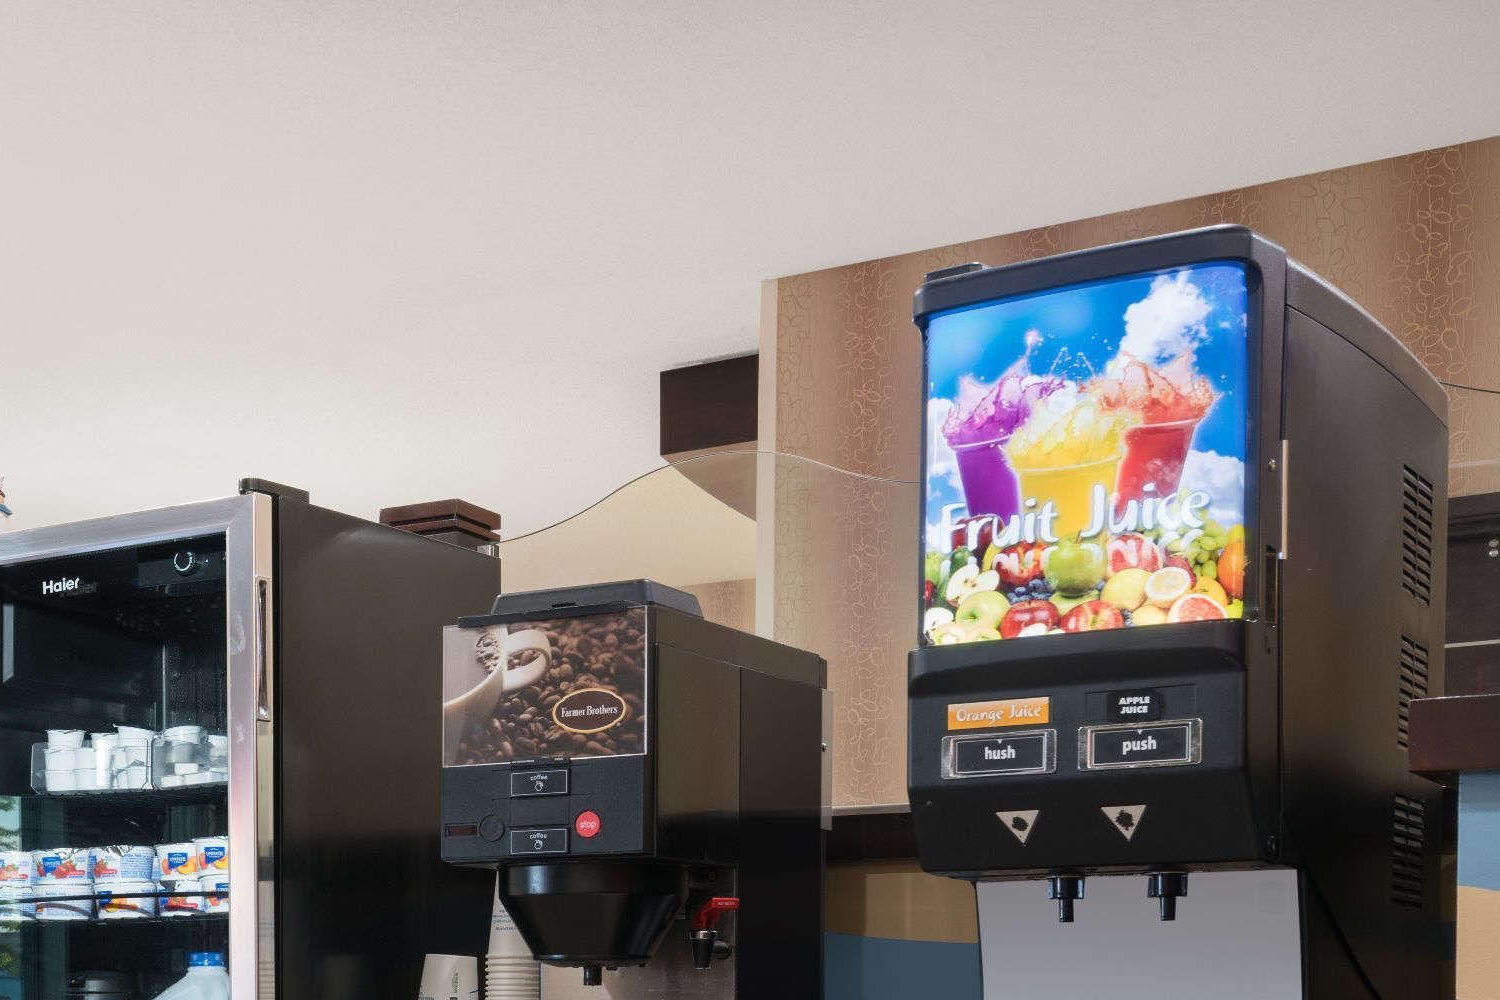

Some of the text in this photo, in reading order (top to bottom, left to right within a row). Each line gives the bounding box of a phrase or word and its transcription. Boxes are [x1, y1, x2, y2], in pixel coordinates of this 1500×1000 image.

[940, 482, 1210, 553] Fruit Juice
[42, 577, 80, 595] Haier
[1118, 696, 1150, 705] APPLE
[561, 705, 619, 718] Farmer Brothers
[956, 704, 1043, 727] Orange Juice
[1120, 706, 1148, 714] JUICE
[1122, 736, 1157, 755] push
